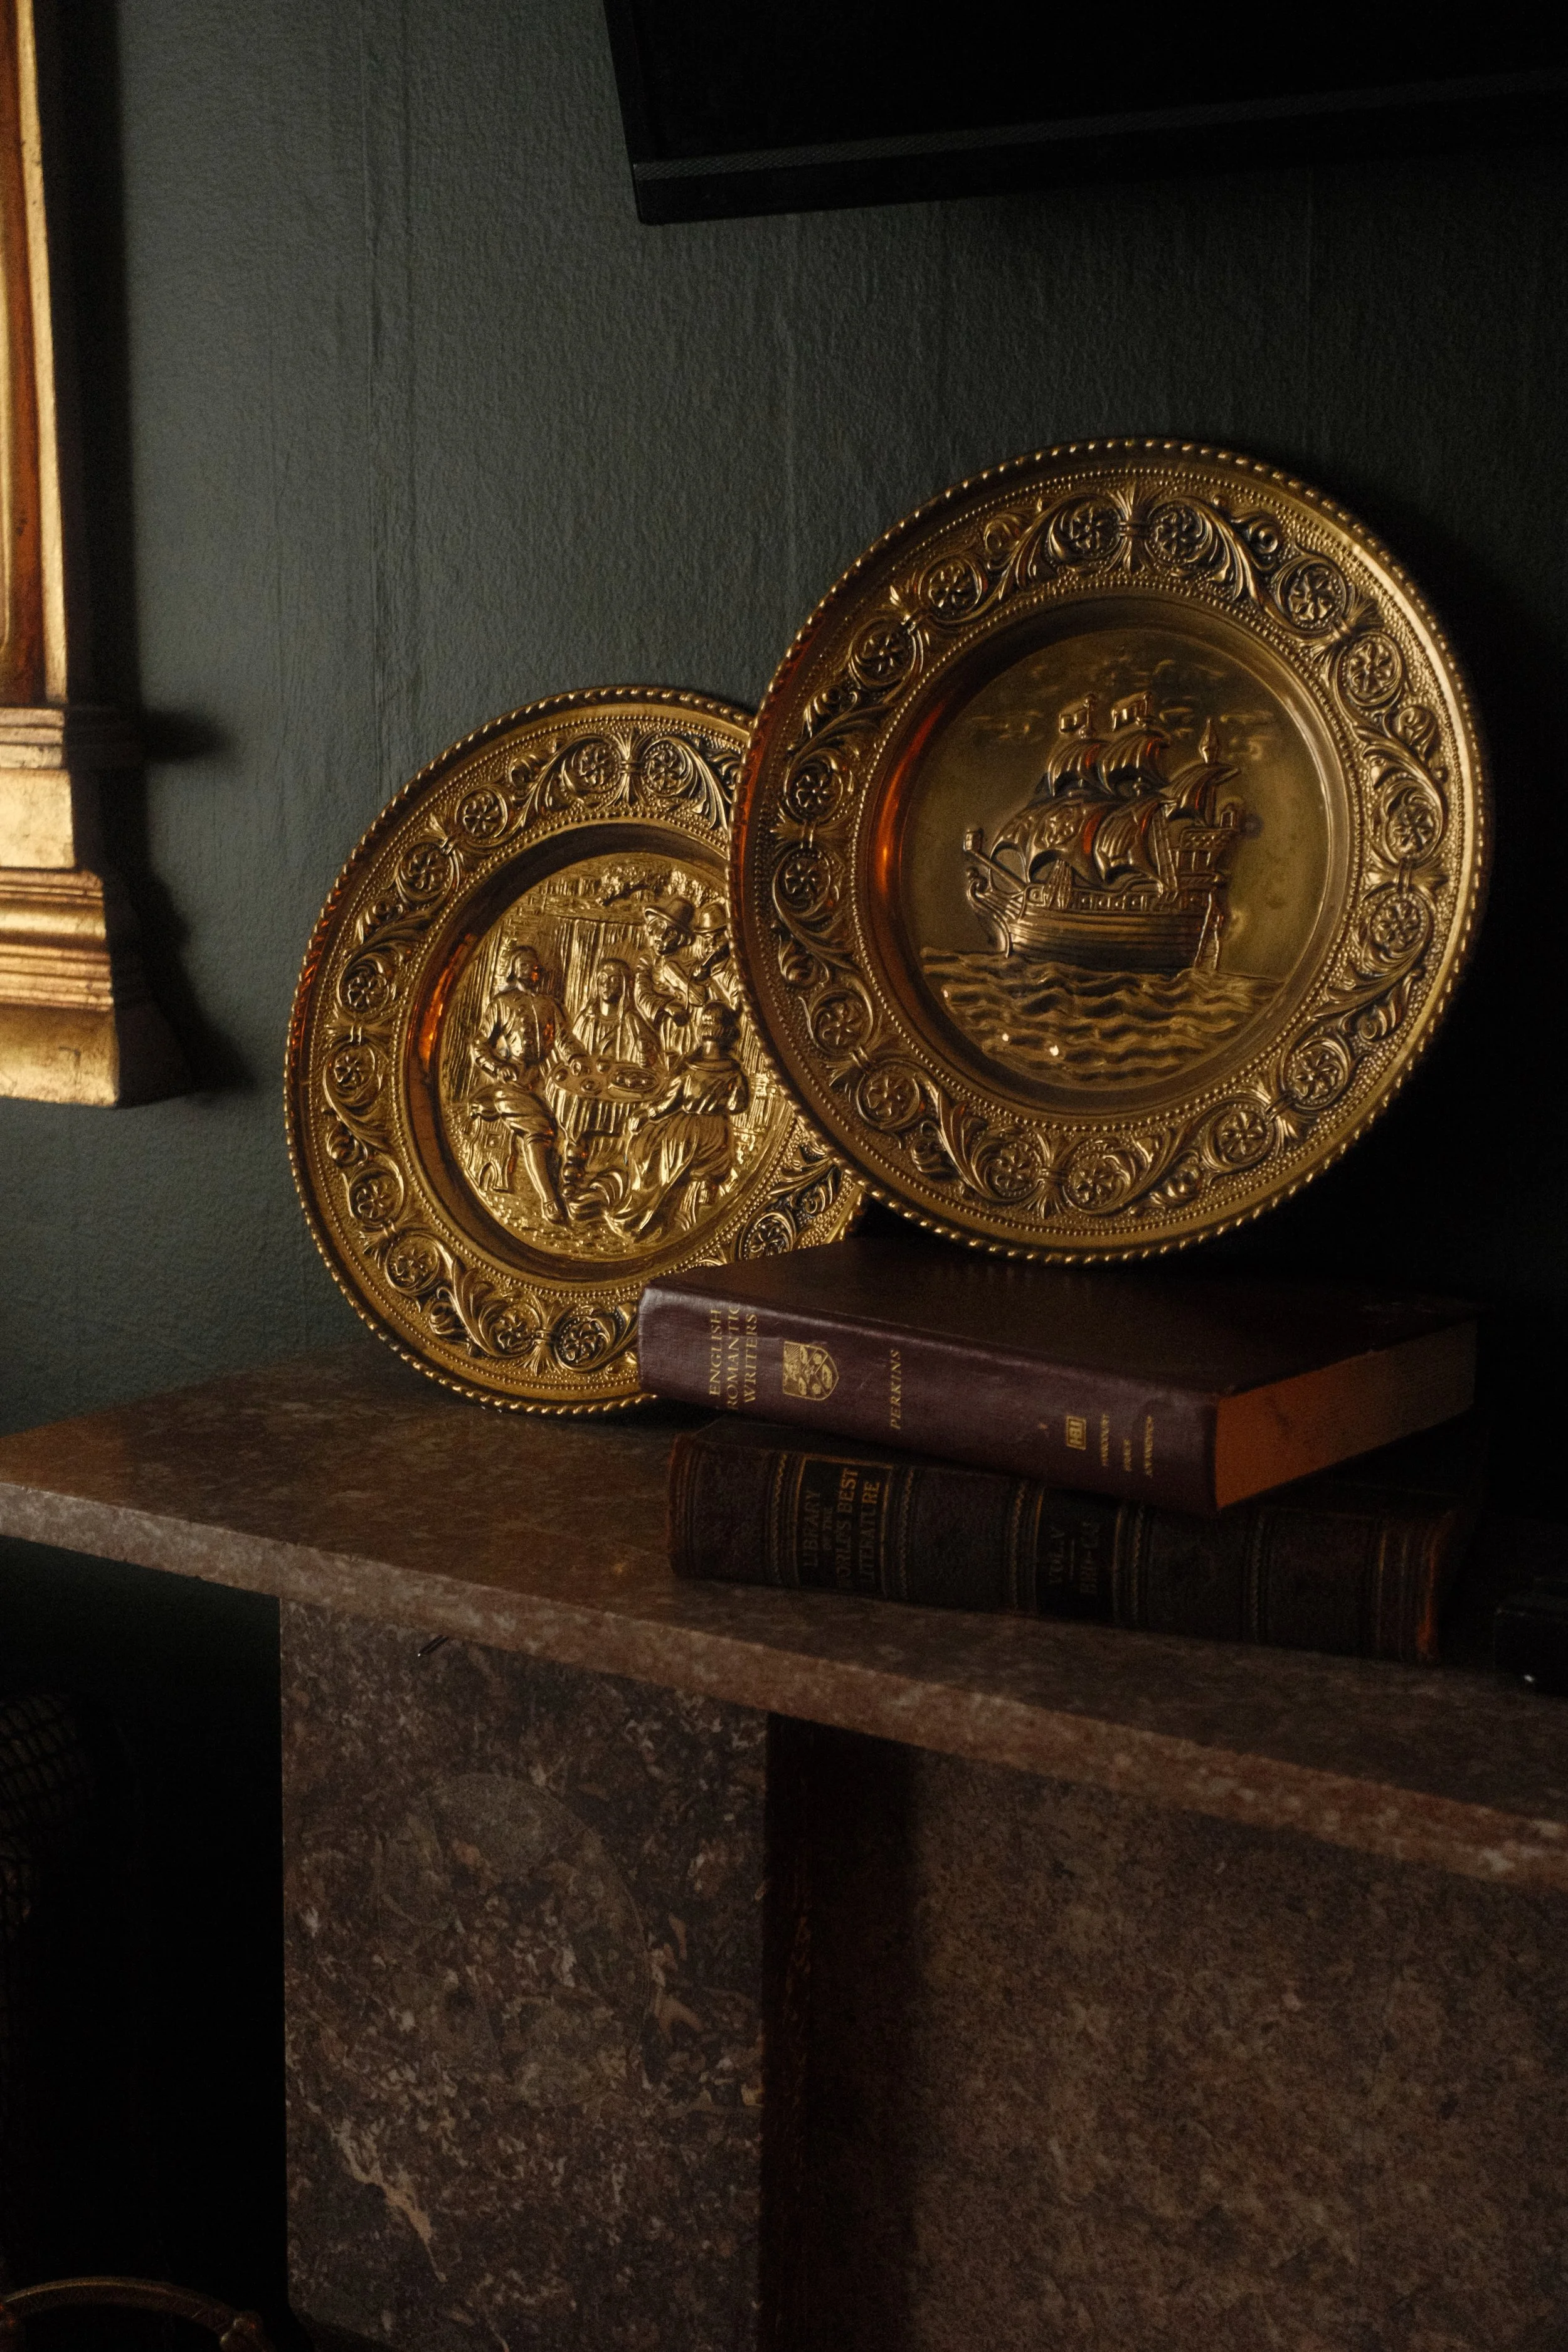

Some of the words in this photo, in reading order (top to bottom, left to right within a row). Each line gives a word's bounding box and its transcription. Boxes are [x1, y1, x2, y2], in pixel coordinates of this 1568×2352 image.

[709, 1309, 722, 1396] ENGLISH
[727, 1305, 741, 1410] ROMANTIC
[743, 1313, 758, 1402] WRITERS
[889, 1350, 902, 1429] PERKINS
[802, 1489, 821, 1567] LIBRARY
[837, 1468, 859, 1513] BEST
[859, 1480, 881, 1586] LITERATURE
